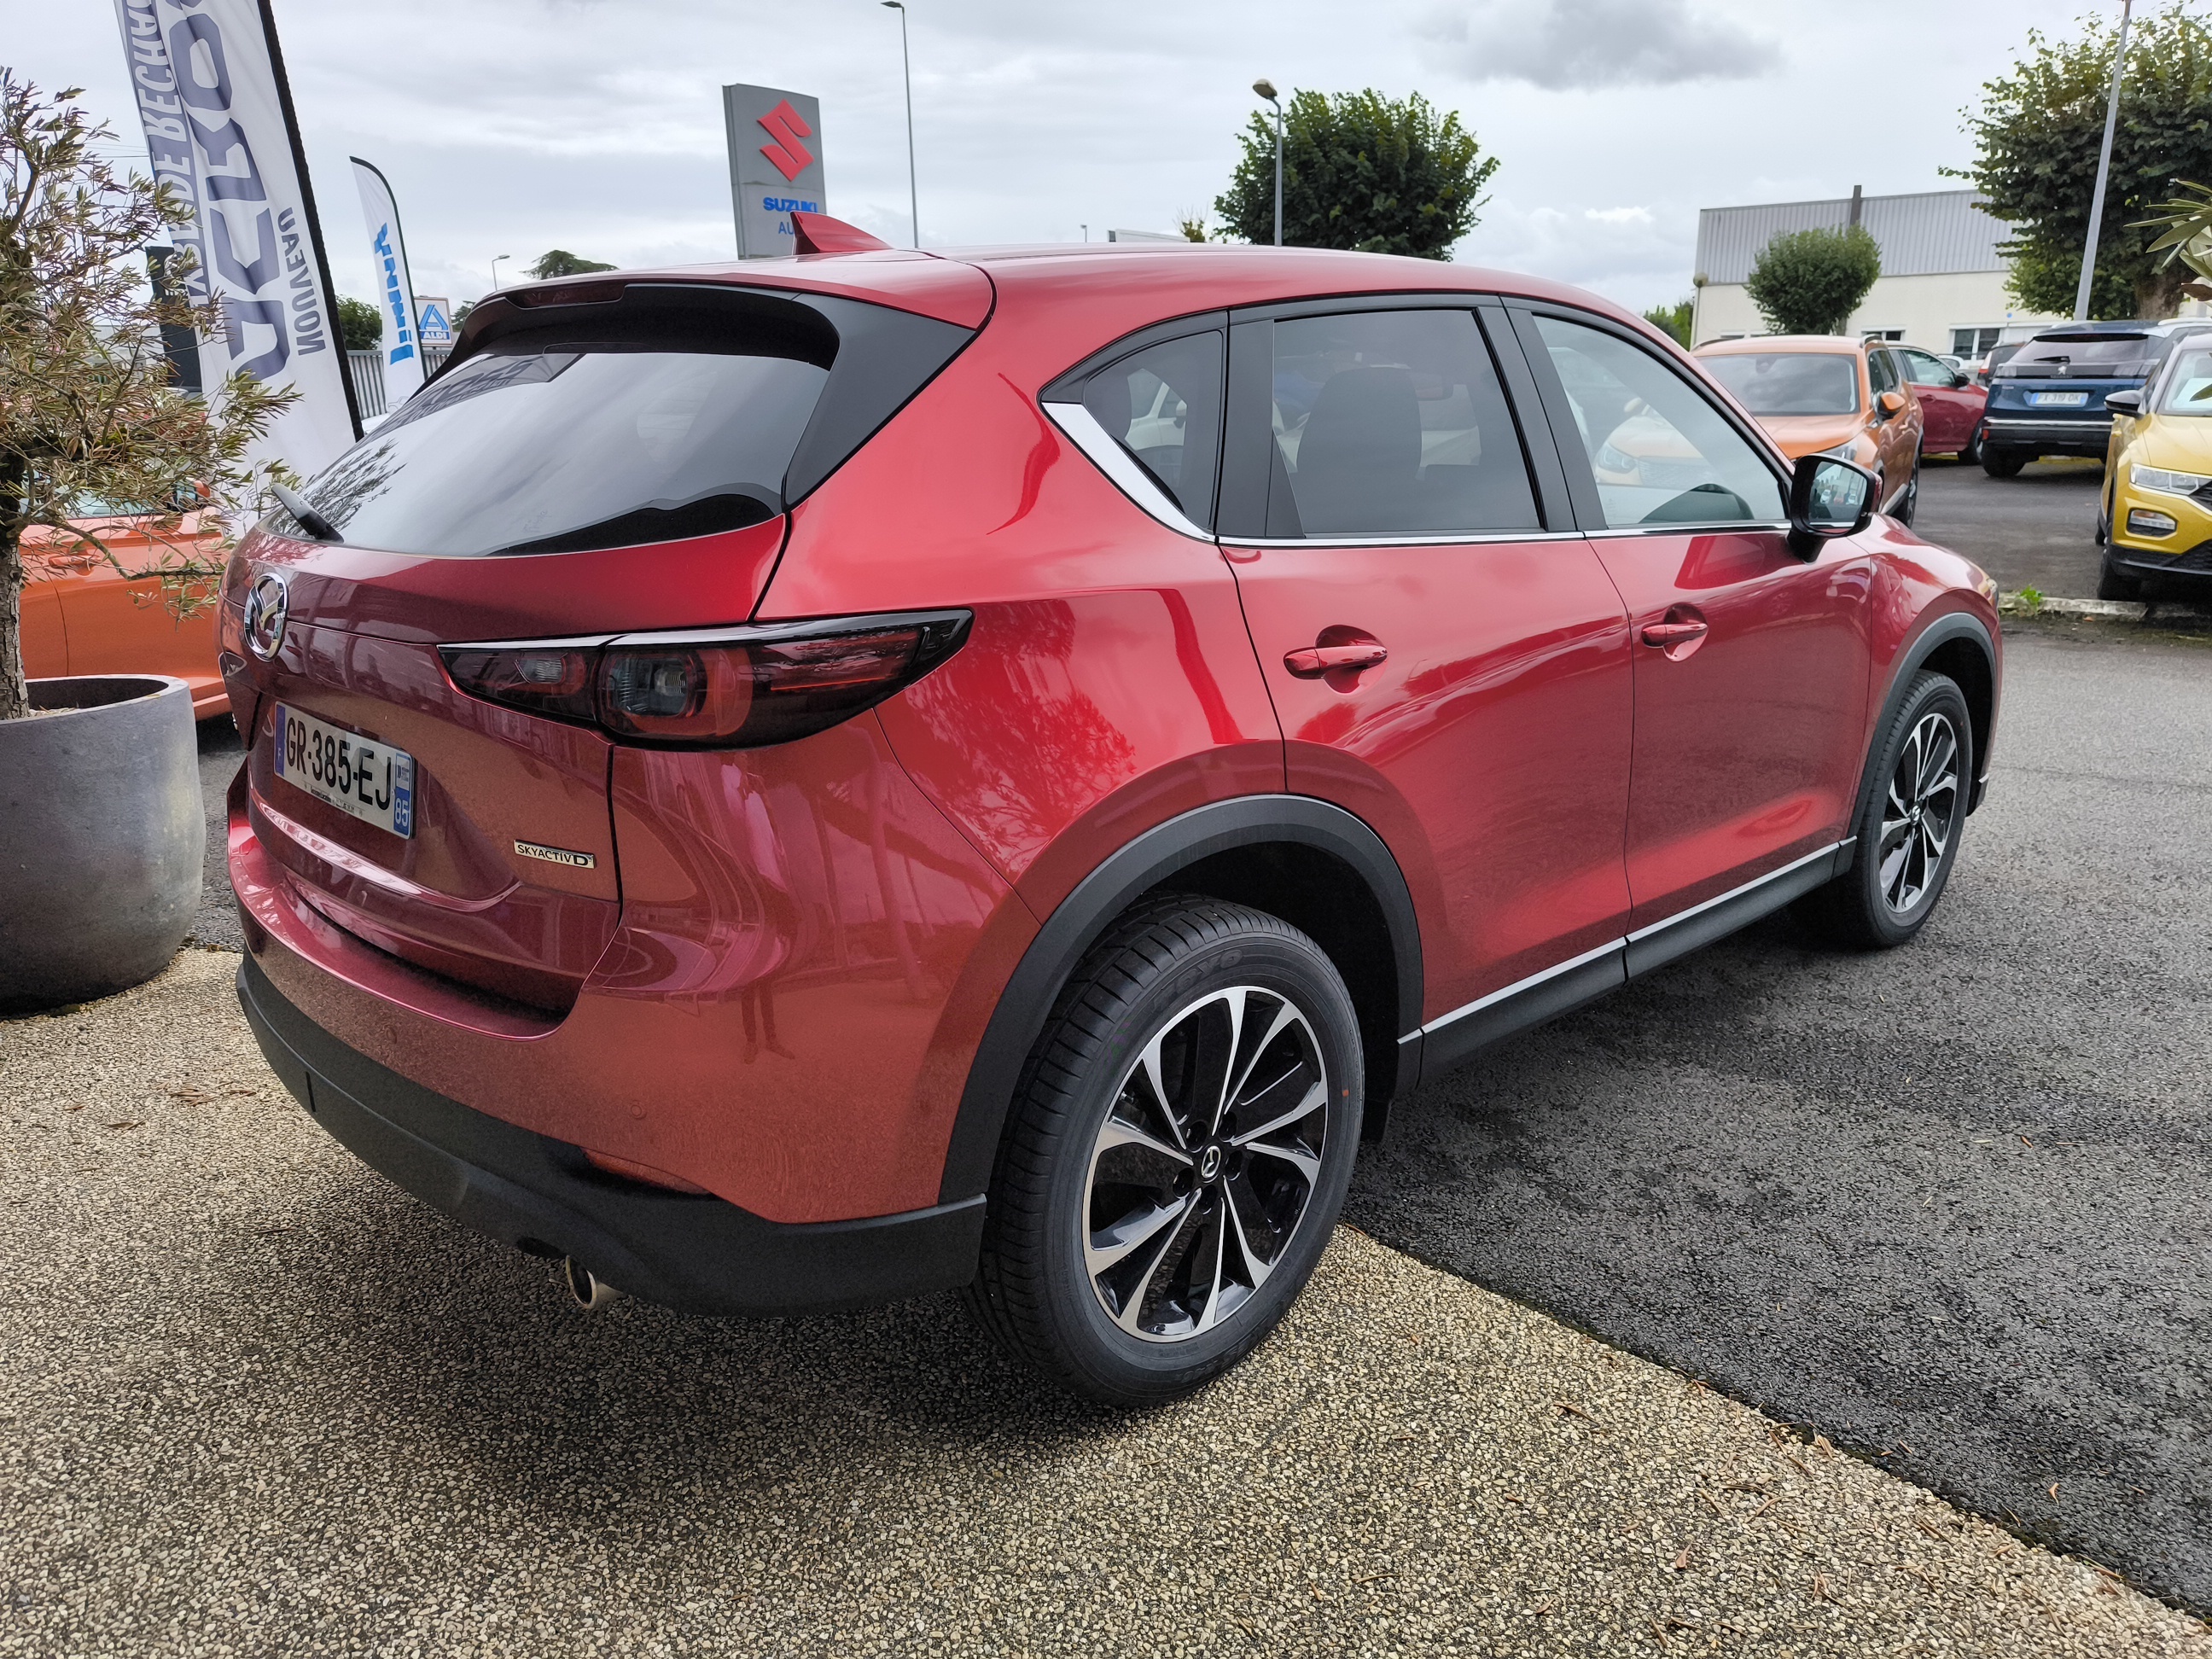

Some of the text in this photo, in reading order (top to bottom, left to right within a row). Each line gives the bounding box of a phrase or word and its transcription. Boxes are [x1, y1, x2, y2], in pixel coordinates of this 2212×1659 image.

[763, 196, 818, 213] SUZUKI
[777, 221, 795, 235] AU
[422, 331, 447, 340] ALDI
[286, 717, 392, 811] GR-385-EJ
[394, 797, 410, 827] 85
